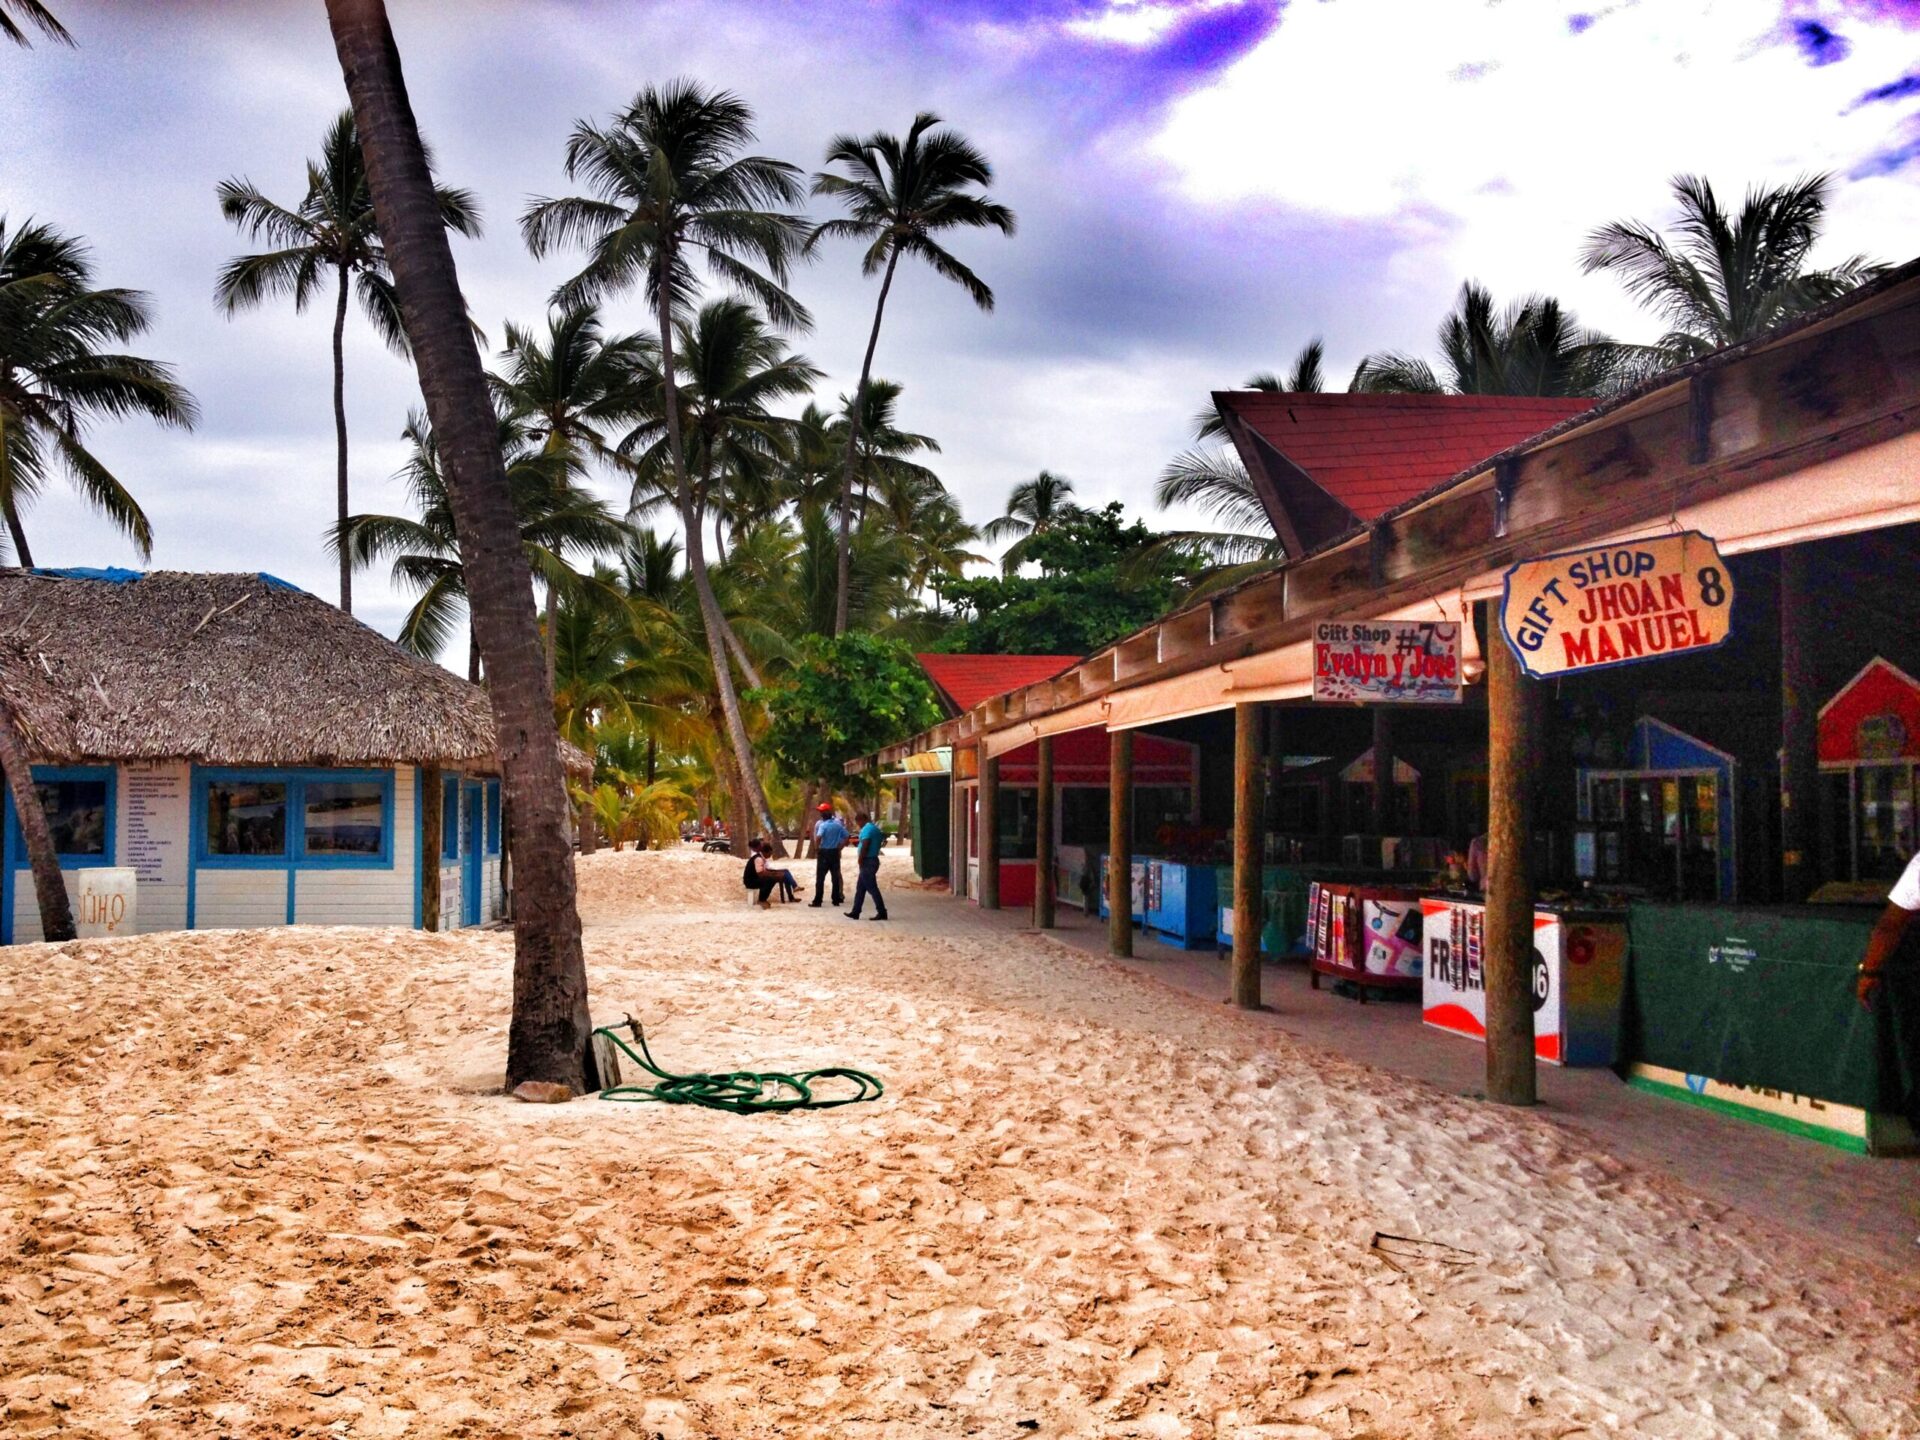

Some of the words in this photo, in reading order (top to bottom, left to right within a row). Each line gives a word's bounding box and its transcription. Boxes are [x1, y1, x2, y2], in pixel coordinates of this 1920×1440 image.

[1516, 577, 1569, 652] GIFT
[1568, 550, 1656, 590] SHOP
[1578, 573, 1686, 624] JHOAN
[1697, 566, 1726, 607] 8
[1317, 623, 1349, 641] Gift
[1352, 624, 1392, 646] Shop
[1395, 623, 1436, 656] #7
[1560, 609, 1711, 668] MANUEL
[1316, 643, 1388, 685] Evelyn
[1391, 652, 1406, 688] y
[1409, 644, 1457, 679] José
